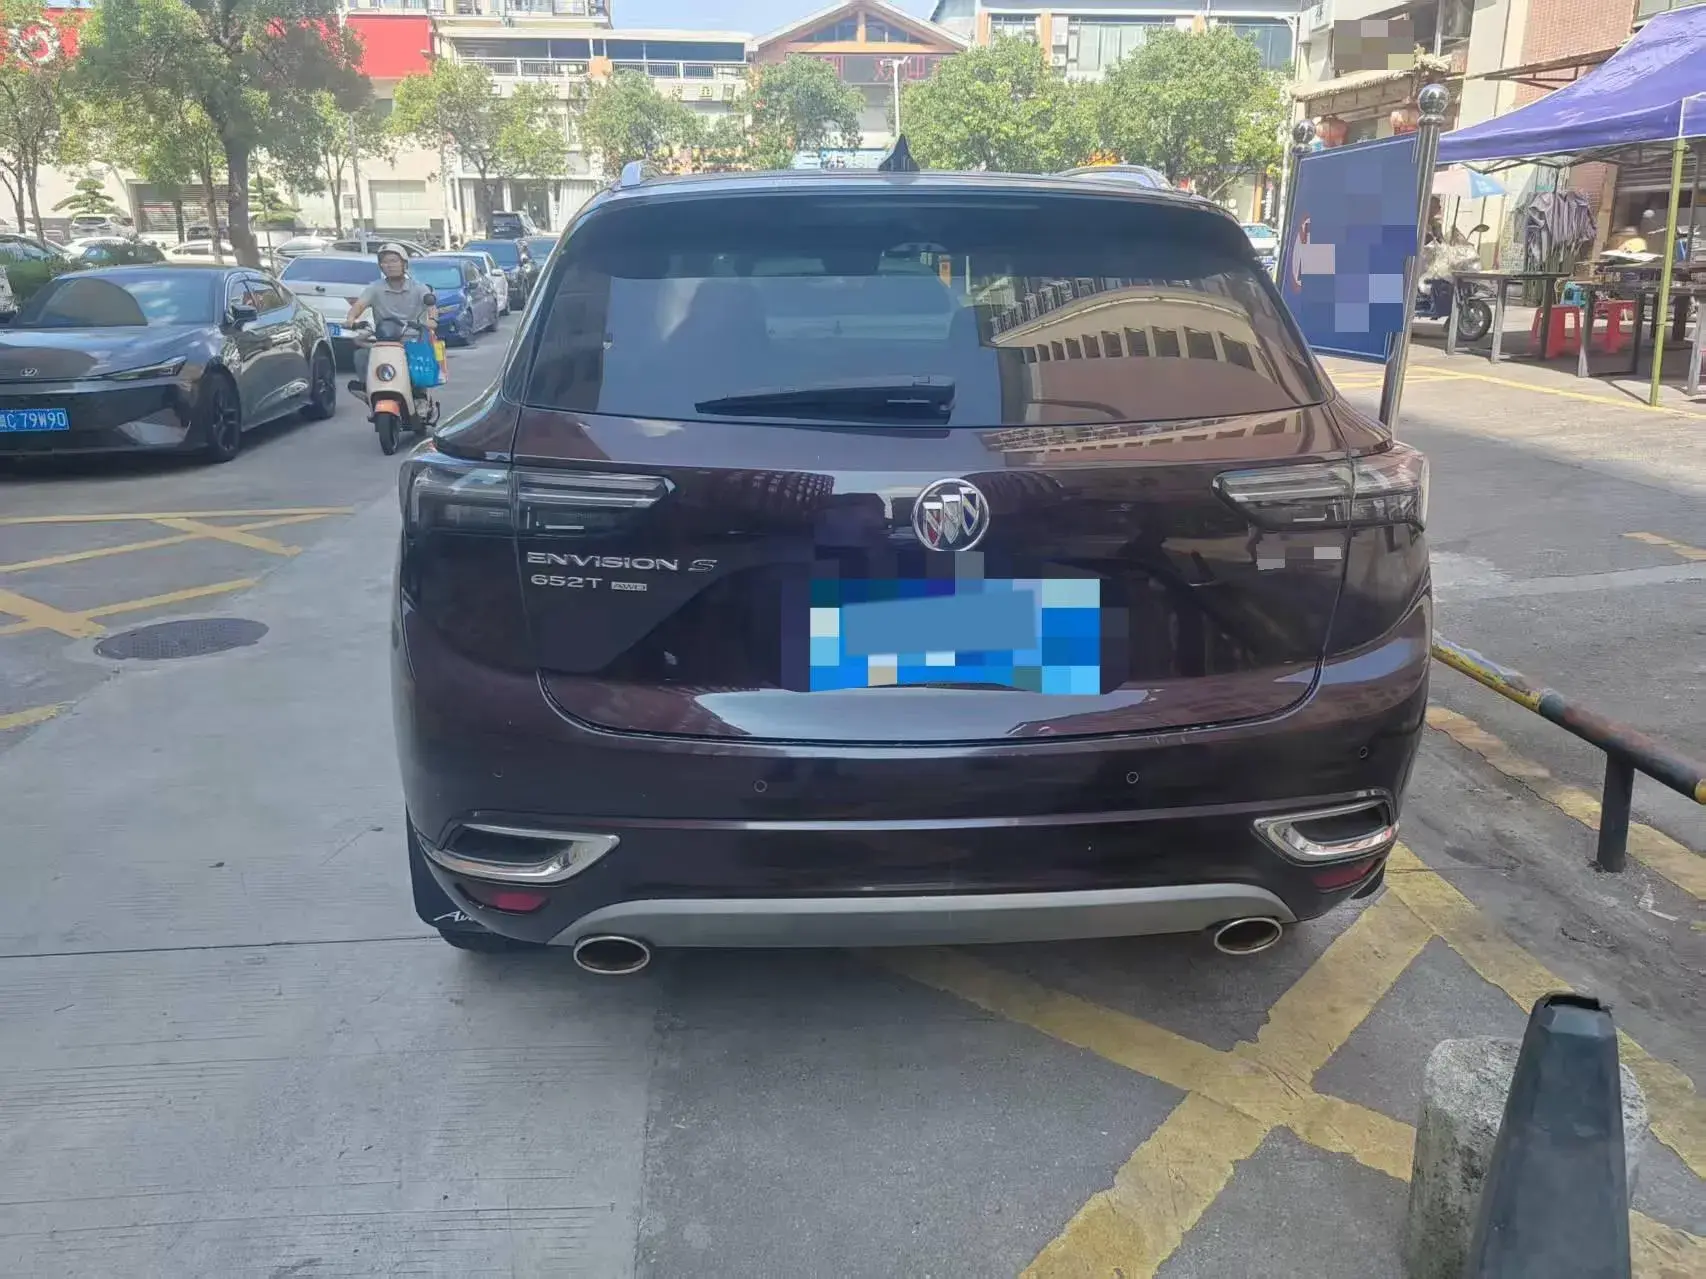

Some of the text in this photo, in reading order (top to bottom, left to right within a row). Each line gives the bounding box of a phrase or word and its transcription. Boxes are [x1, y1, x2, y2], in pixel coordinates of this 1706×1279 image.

[527, 551, 718, 572] ENVISION S
[530, 574, 603, 589] 652T
